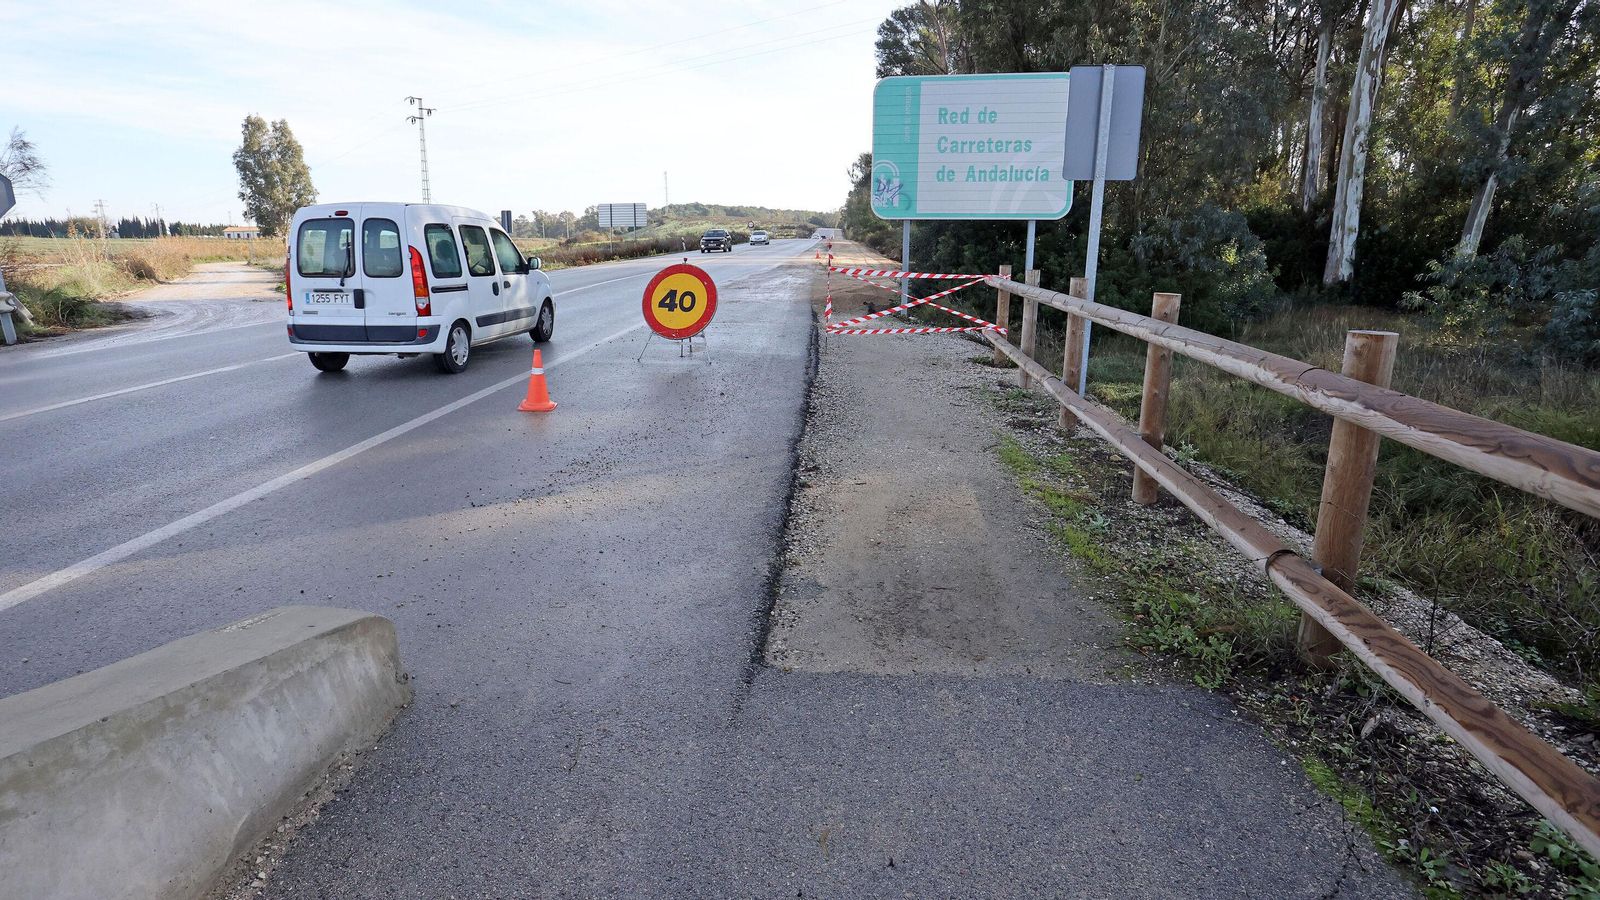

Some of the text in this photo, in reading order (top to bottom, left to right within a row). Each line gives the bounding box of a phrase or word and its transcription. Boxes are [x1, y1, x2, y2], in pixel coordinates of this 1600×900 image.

[938, 107, 998, 125] Red de
[937, 136, 1033, 154] Carreteras
[936, 164, 1050, 183] de Andalucía
[311, 294, 331, 303] 1255
[334, 294, 350, 303] FYT
[658, 289, 696, 313] 40
